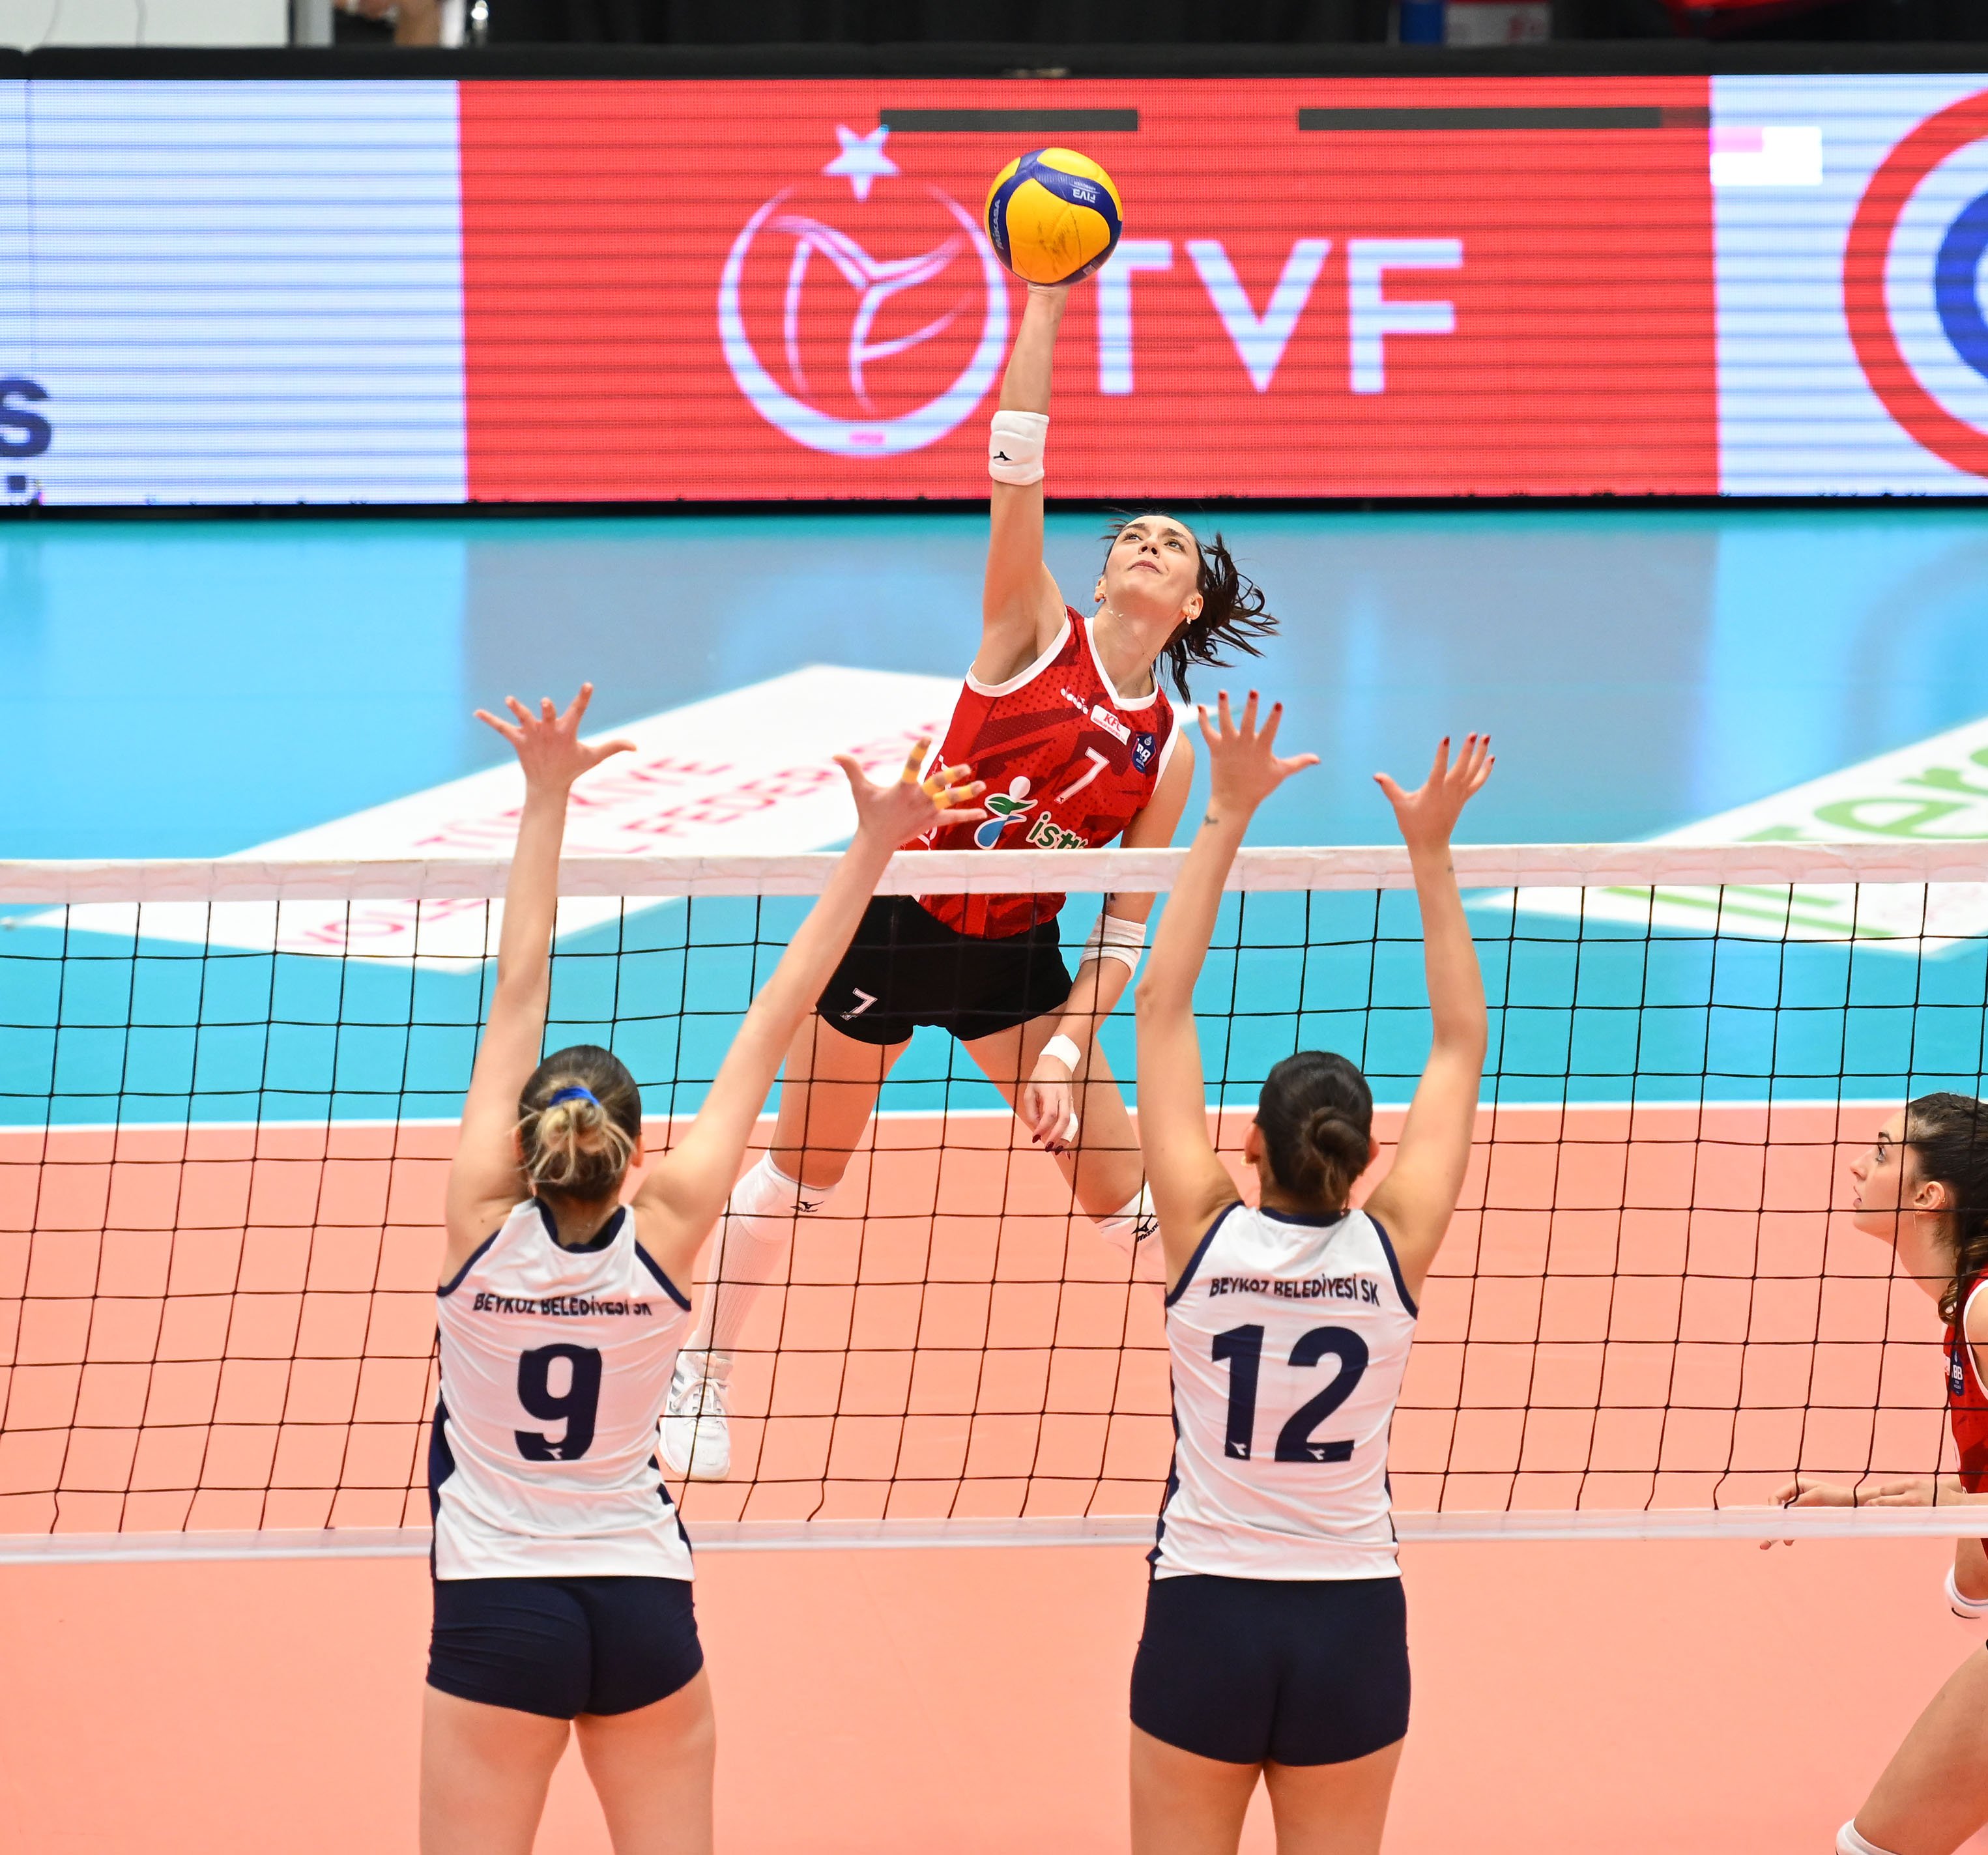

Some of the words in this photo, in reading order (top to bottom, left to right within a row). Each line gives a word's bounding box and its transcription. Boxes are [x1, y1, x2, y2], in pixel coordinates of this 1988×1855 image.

[1073, 188, 1096, 203] FIVB
[1095, 238, 1464, 395] TVF
[1054, 746, 1110, 804] 7
[840, 987, 878, 1021] 7
[472, 1292, 536, 1315] BEYKOZ
[1209, 1276, 1270, 1298] BEYKOZ
[1273, 1273, 1358, 1300] BELEDİYESİ
[1361, 1278, 1381, 1307] SK
[514, 1343, 602, 1461] 9
[1211, 1323, 1369, 1463] 12
